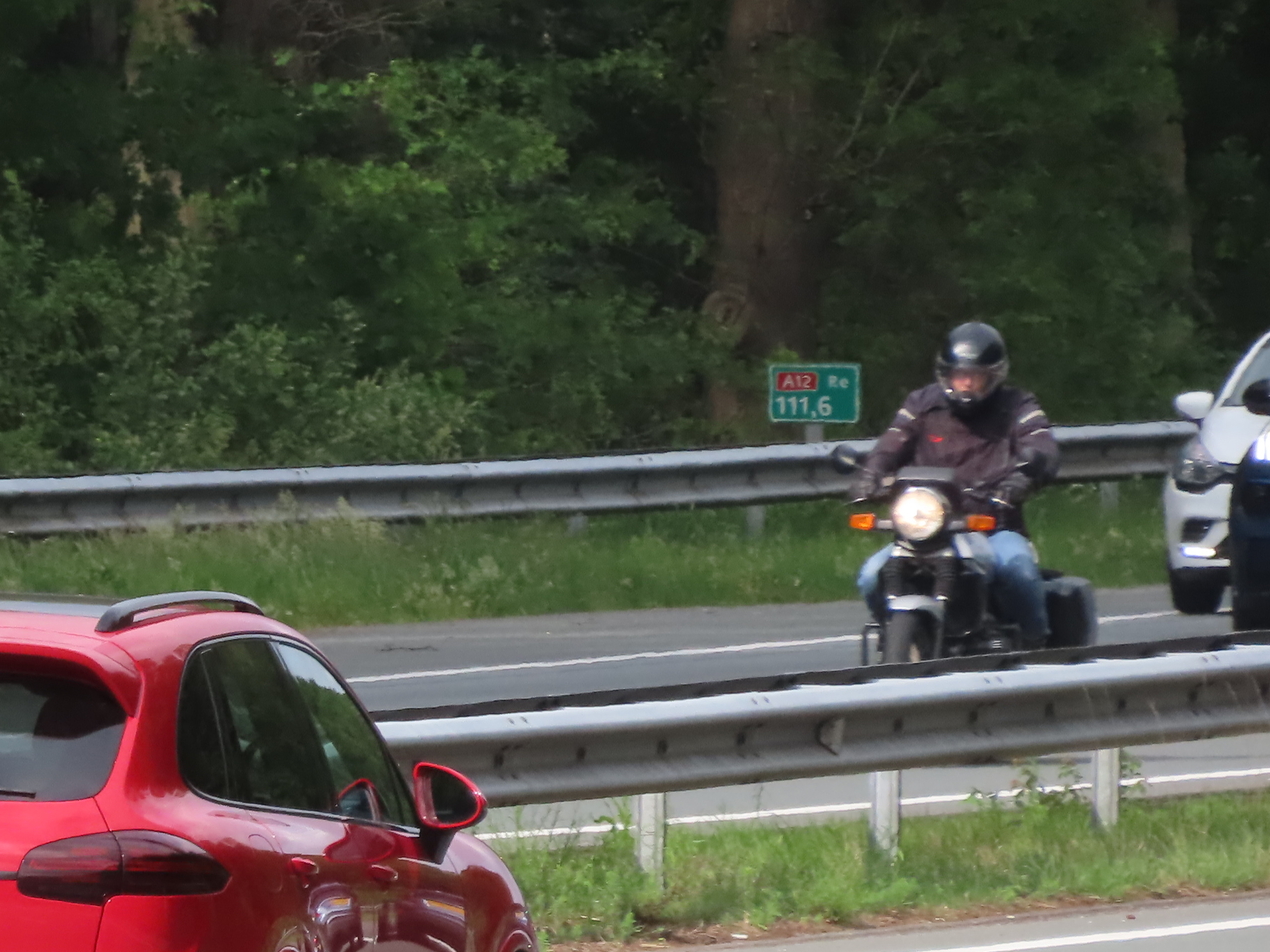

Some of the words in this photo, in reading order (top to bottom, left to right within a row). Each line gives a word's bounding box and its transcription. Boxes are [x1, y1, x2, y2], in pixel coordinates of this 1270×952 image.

[782, 375, 812, 388] A12
[828, 375, 849, 389] Re
[775, 396, 832, 418] 111,6
